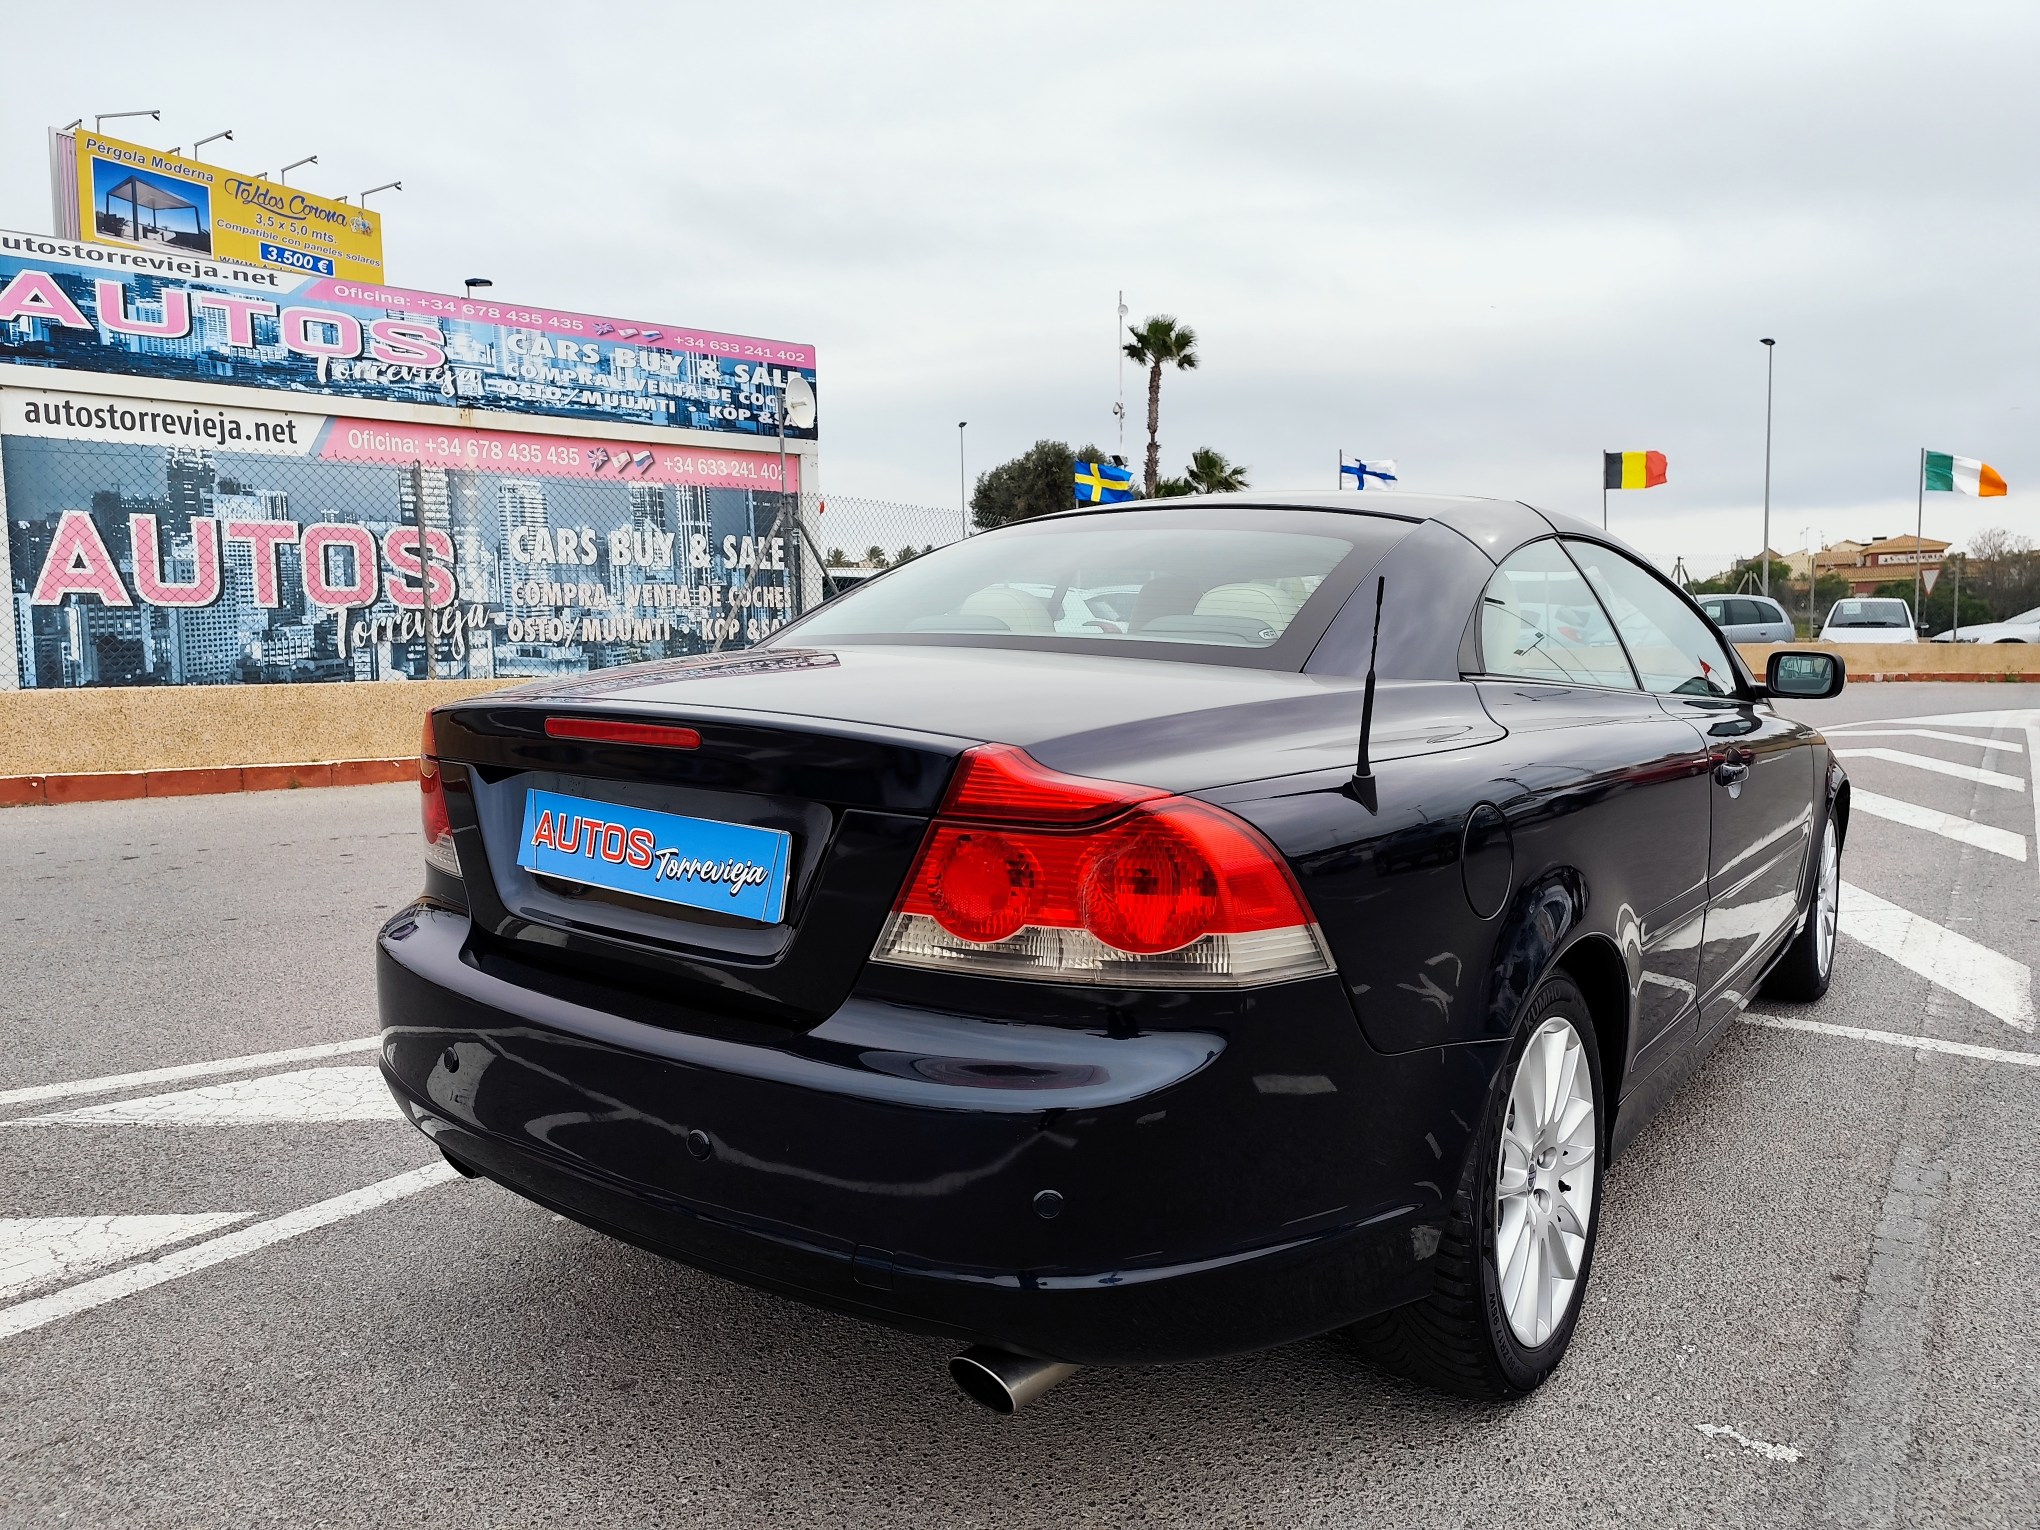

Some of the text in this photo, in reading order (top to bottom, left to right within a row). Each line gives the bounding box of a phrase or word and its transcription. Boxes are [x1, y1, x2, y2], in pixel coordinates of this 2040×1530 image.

[86, 138, 214, 182] Pérgola Moderna
[225, 178, 347, 227] Toldos Corona
[217, 218, 380, 267] Compatible con paneles solares
[255, 213, 337, 244] 3,5 x 5,0 mts.
[2, 236, 279, 287] utostorrevieja.net
[267, 246, 314, 269] 3.500
[317, 259, 329, 273] €
[0, 269, 447, 369] AUTOS
[334, 285, 805, 363] Oficina: +34 678 435 435 +34 633 241 402
[314, 352, 484, 398] Torrevieja
[506, 333, 600, 364] CARS
[614, 347, 684, 376] BUY
[698, 360, 721, 380] &
[707, 386, 732, 402] DE
[709, 404, 751, 421] KÖP
[25, 399, 298, 446] autostorrevieja.net
[348, 429, 420, 454] Oficina:
[425, 436, 461, 457] +34
[466, 438, 503, 460] 678
[507, 442, 542, 464] 435
[546, 445, 581, 466] 435
[664, 456, 694, 474] +34
[697, 459, 727, 476] 633
[730, 461, 757, 479] 241
[31, 509, 459, 610] AUTOS
[509, 525, 785, 571] CARS BUY & SALE
[627, 583, 691, 607] VENTA
[698, 585, 722, 608] DE
[325, 600, 491, 661] Torrevieja
[701, 611, 740, 641] KÖP
[530, 809, 769, 895] AUTOS Torrevieja
[1524, 985, 1561, 1032] KUMHO
